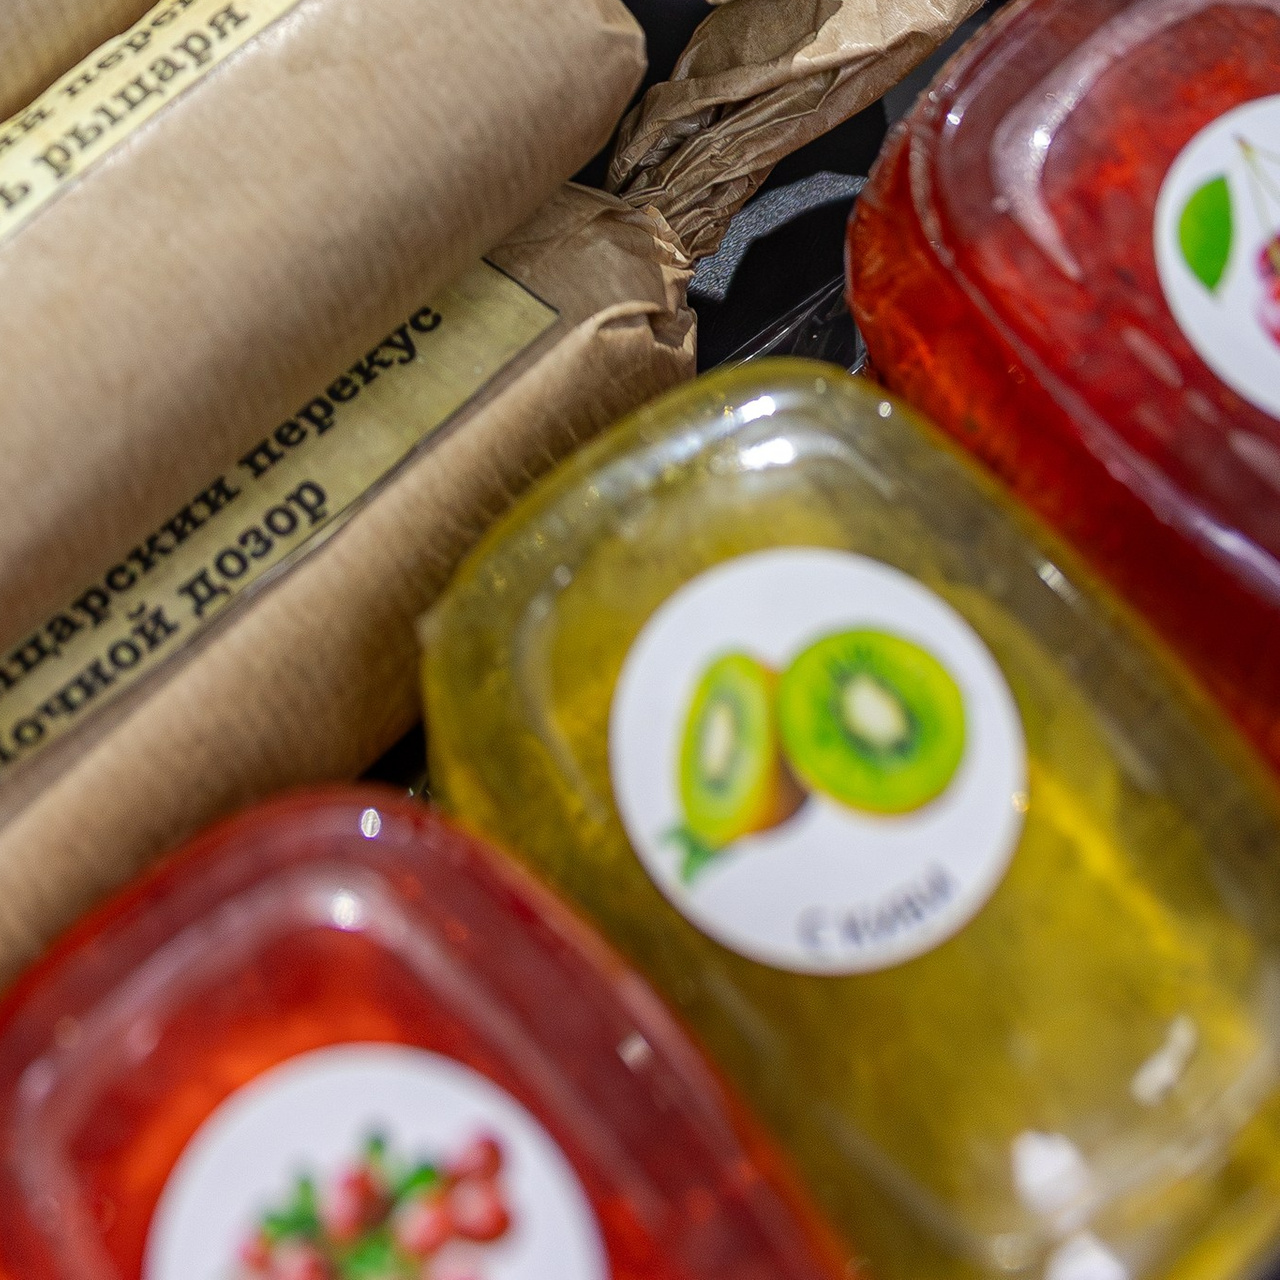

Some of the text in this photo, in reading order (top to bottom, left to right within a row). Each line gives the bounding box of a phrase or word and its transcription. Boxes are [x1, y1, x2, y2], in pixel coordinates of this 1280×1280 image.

[34, 2, 252, 181] рыцаря
[239, 303, 445, 481] перекус
[177, 476, 329, 619] дозор
